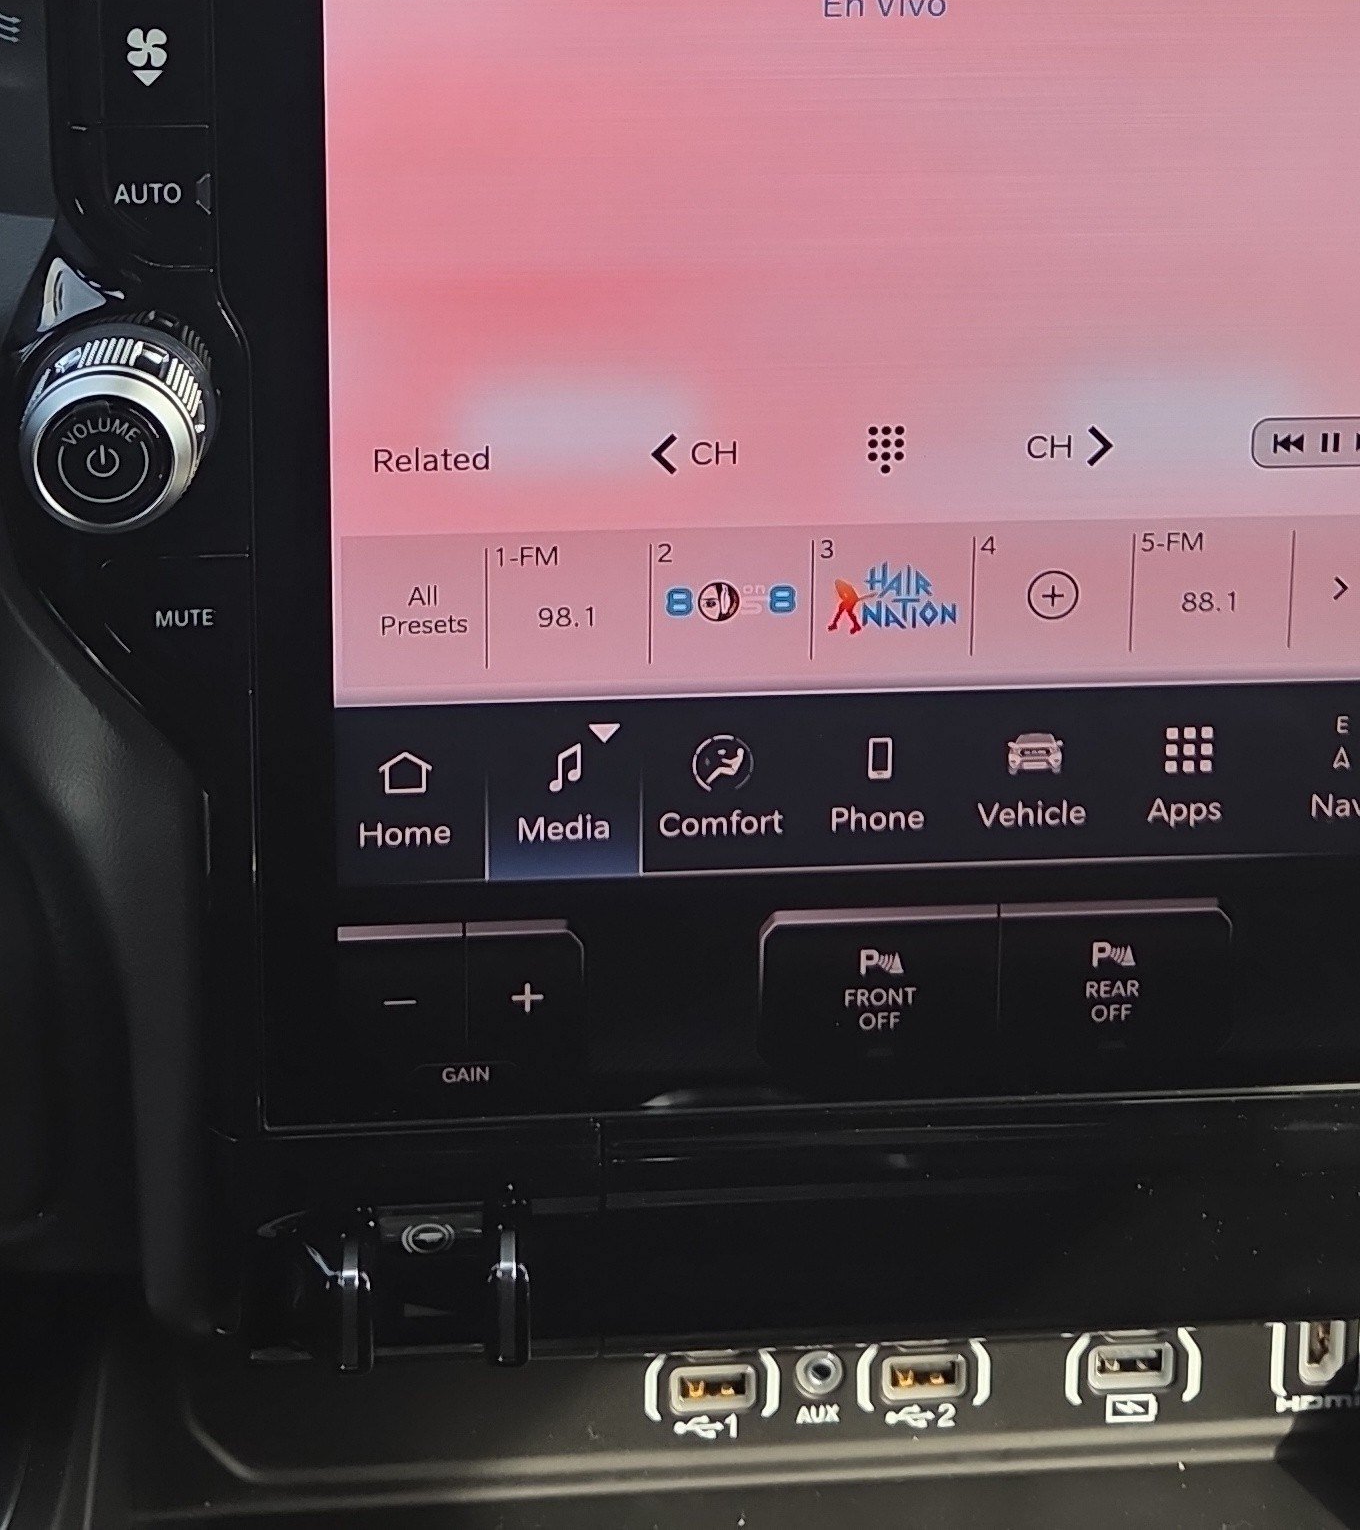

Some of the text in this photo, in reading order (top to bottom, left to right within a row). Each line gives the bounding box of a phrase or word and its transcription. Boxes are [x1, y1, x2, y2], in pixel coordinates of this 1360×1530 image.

[114, 180, 182, 206] AUTO
[62, 418, 142, 447] VOLUME
[690, 442, 737, 466] CH
[1027, 435, 1072, 460] CH
[373, 446, 491, 473] Related
[658, 543, 673, 563] 2
[821, 540, 834, 559] 3
[980, 536, 996, 554] 4
[1141, 532, 1204, 552] 5-FM
[495, 546, 559, 566] 1-FM
[866, 562, 932, 598] HAIR
[408, 585, 438, 607] All
[1181, 592, 1238, 612] 88.1
[155, 608, 214, 627] MUTE
[538, 607, 596, 628] 98.1
[862, 598, 957, 628] NATION
[381, 615, 468, 636] Presets
[831, 806, 925, 834] Phone
[978, 800, 1086, 828] Vehicle
[1148, 797, 1223, 828] Apps
[359, 820, 451, 849] Home
[518, 813, 610, 844] Media
[659, 809, 784, 839] Comfort
[844, 986, 917, 1008] FRONT
[1085, 980, 1140, 998] REAR
[858, 1012, 901, 1031] OFF
[1090, 1004, 1132, 1022] OFF
[442, 1067, 490, 1083] GAIN
[796, 1404, 839, 1425] AUX
